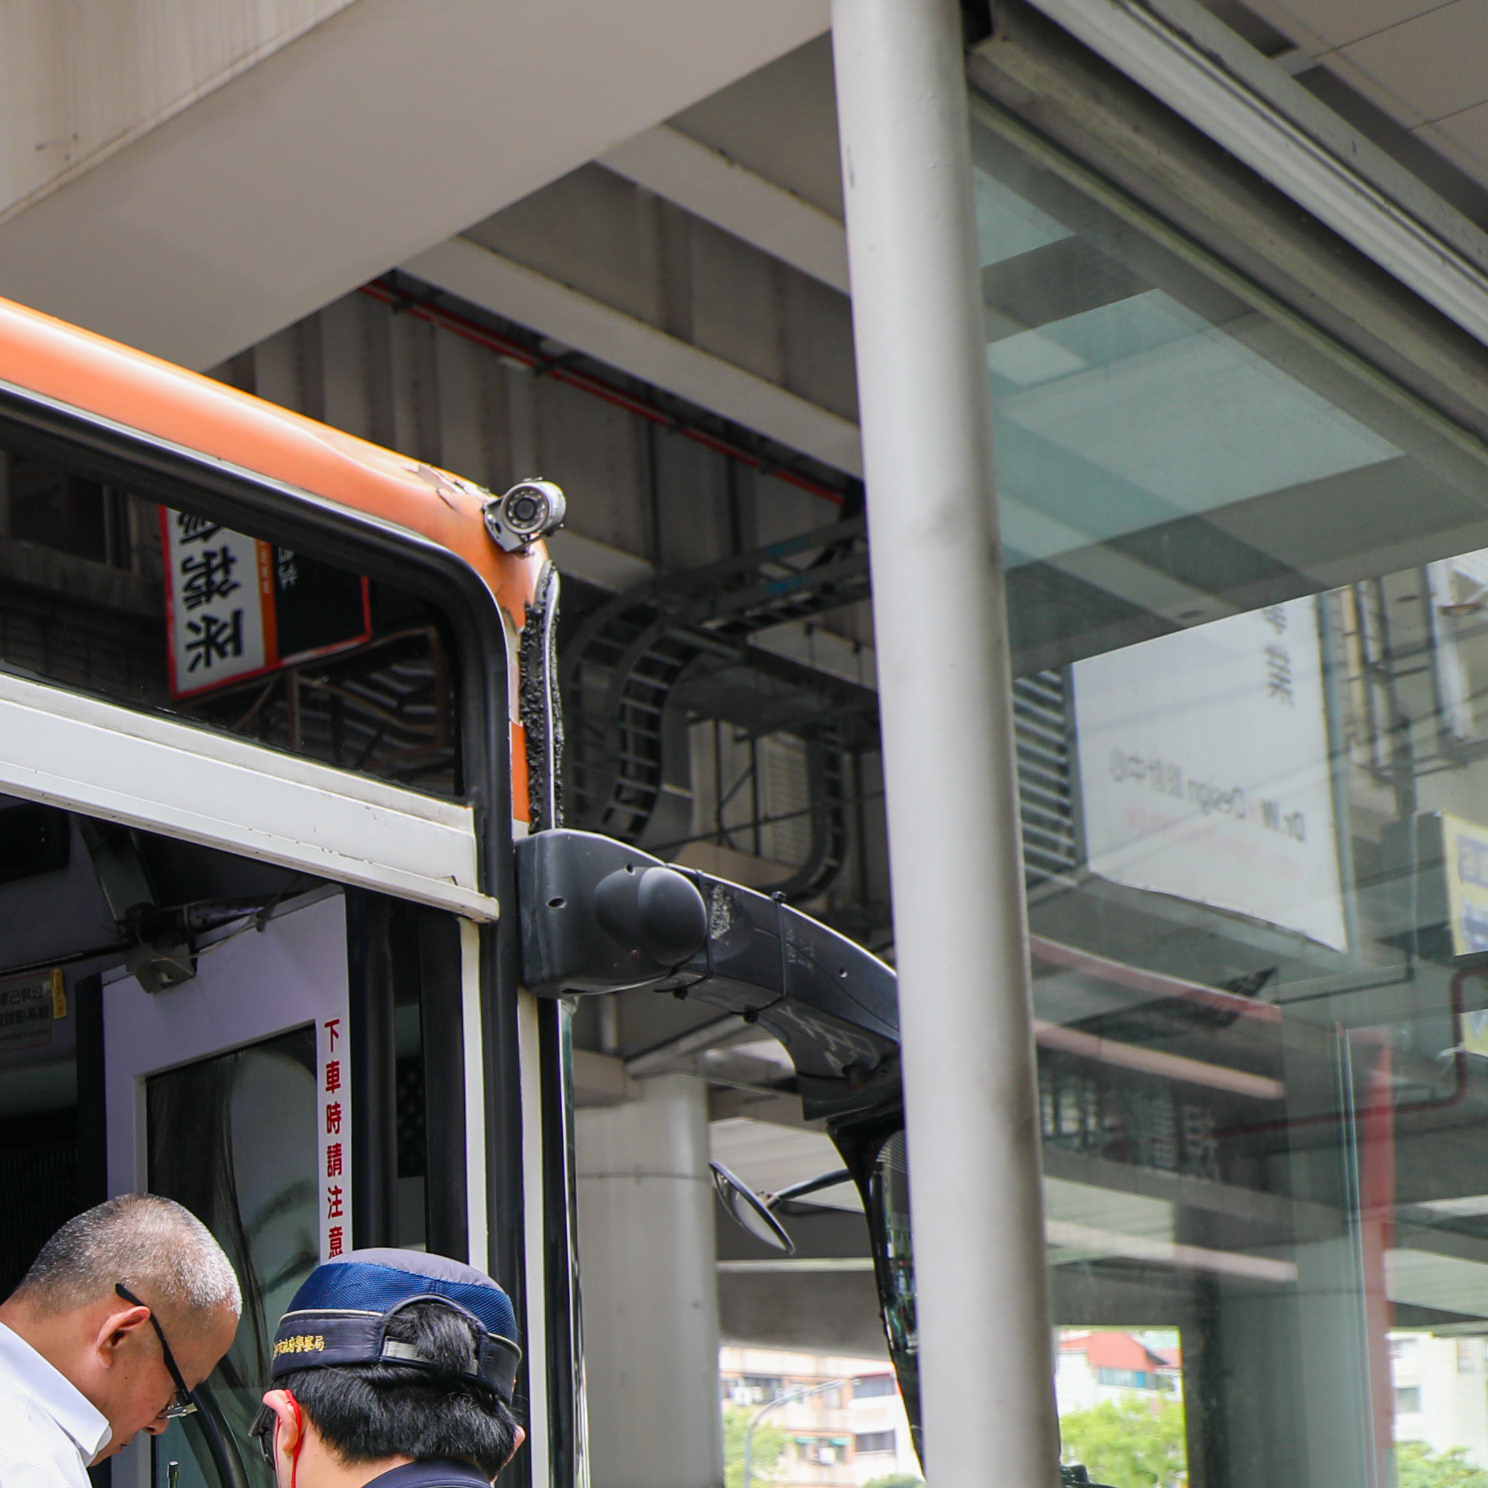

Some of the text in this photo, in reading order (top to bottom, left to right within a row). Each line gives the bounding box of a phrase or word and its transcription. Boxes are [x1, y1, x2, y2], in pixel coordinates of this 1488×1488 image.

[324, 1018, 343, 1259] 下車時請注意
